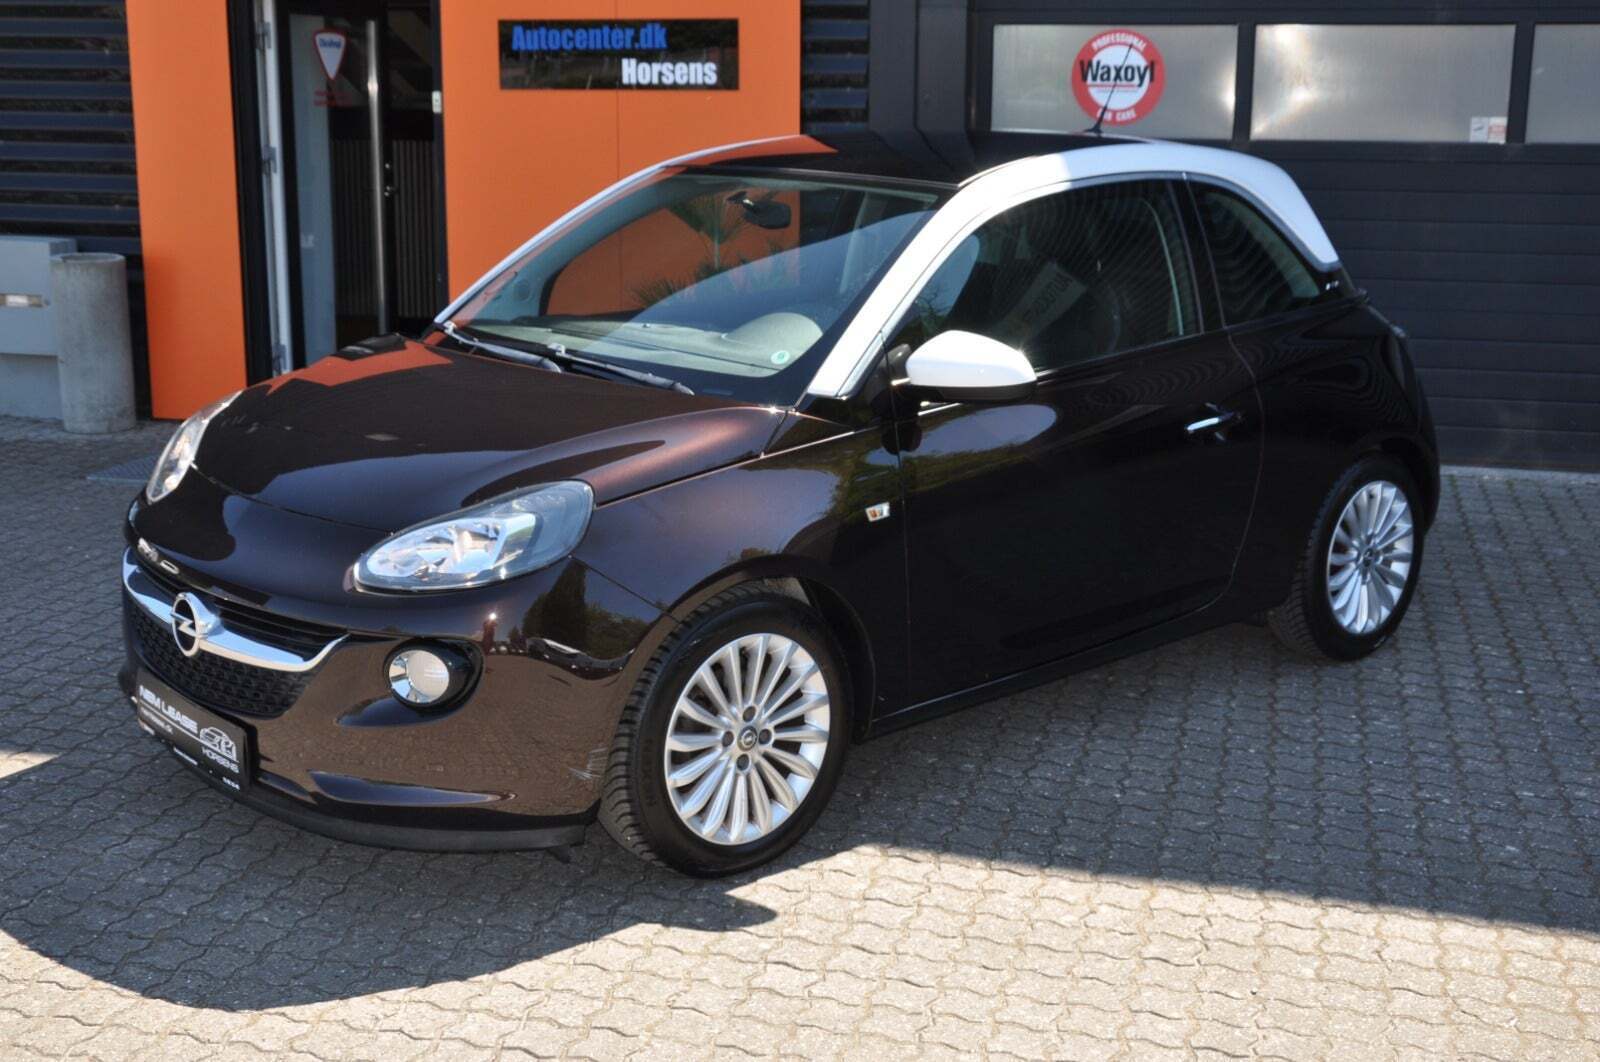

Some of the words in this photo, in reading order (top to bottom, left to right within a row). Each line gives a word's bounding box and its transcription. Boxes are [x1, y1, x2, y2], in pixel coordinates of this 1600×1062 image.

[512, 23, 668, 51] Autocenter.dk
[621, 57, 718, 86] Horsens
[1080, 60, 1155, 88] Waxoyl
[161, 701, 198, 735] LEASE
